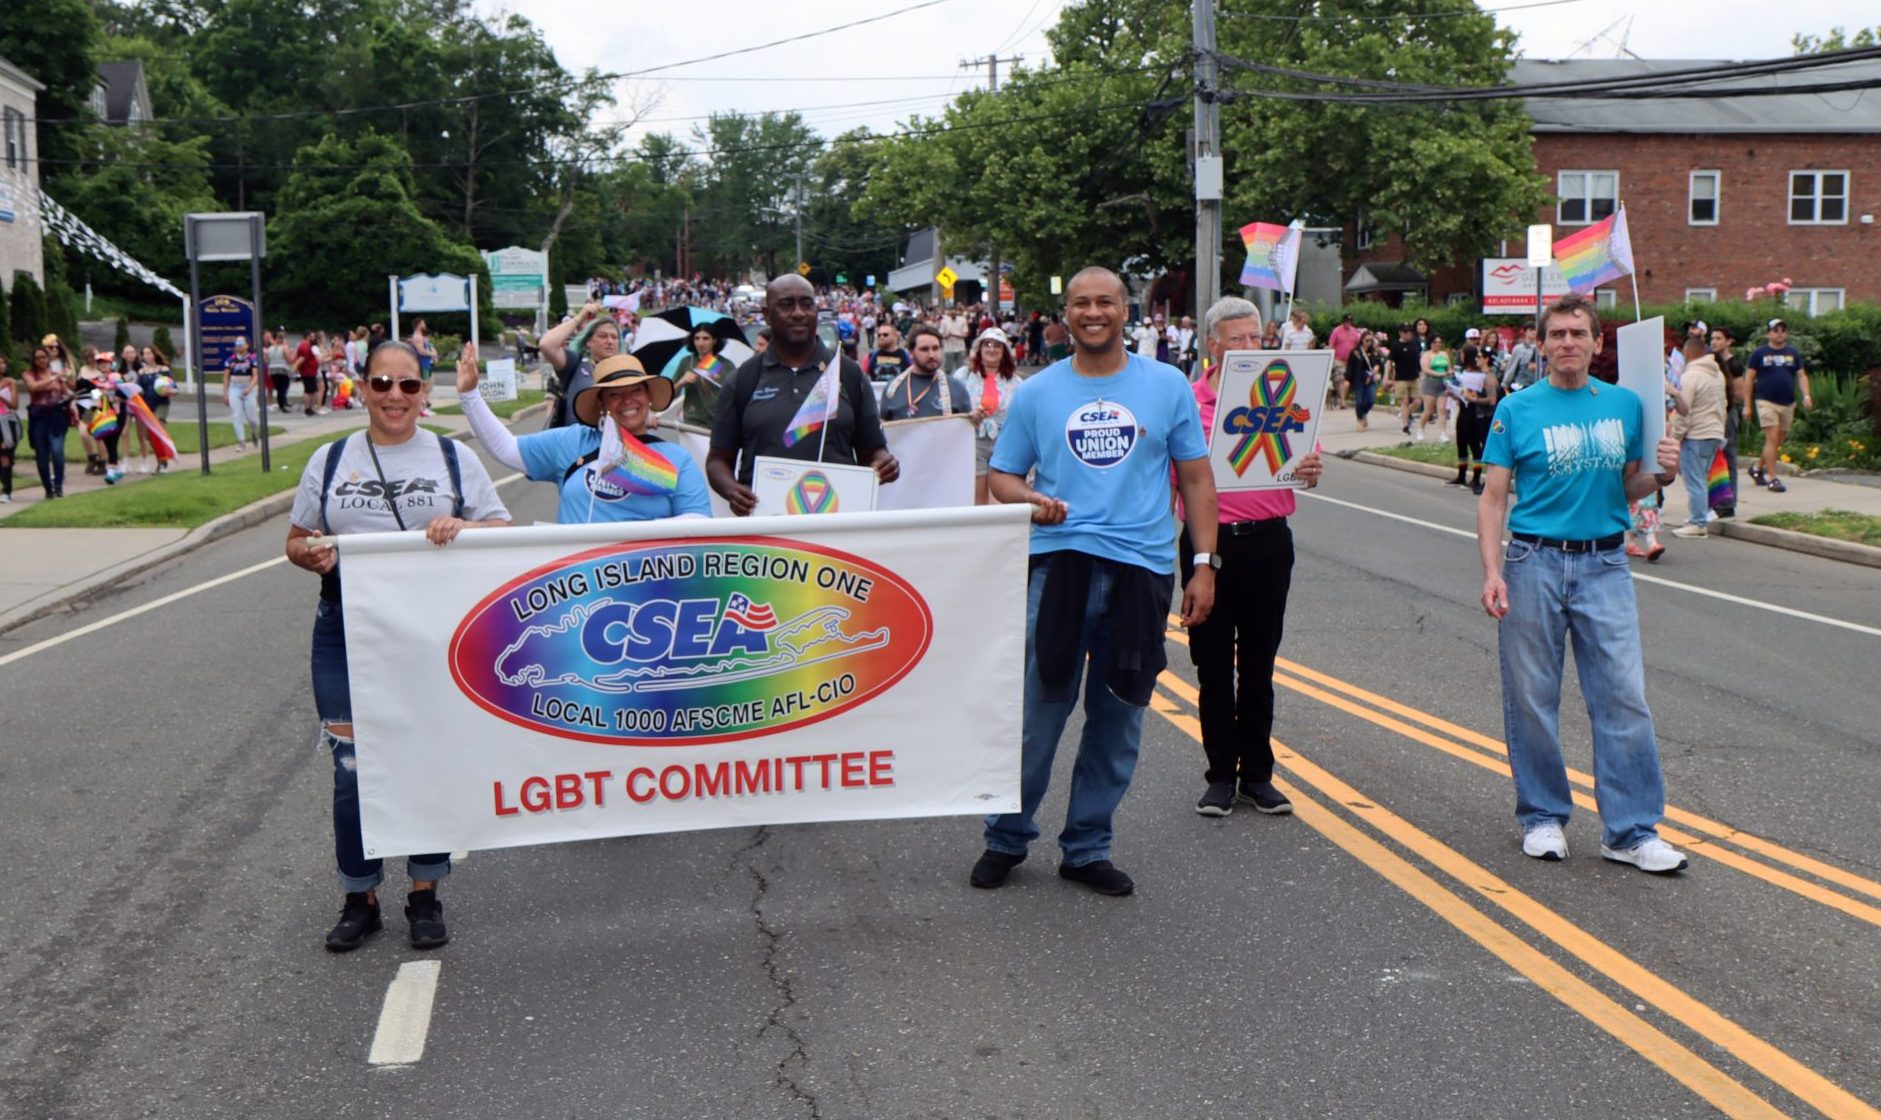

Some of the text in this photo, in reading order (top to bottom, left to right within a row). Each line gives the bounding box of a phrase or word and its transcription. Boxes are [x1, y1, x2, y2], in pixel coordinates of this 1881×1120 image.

[1080, 410, 1120, 422] CSEA
[1223, 404, 1308, 435] CSEA
[1076, 435, 1129, 452] UNION
[1084, 428, 1121, 438] PROUD
[1082, 449, 1124, 459] MEMBER
[335, 477, 440, 499] CSEA
[407, 496, 434, 508] 881
[512, 552, 874, 621] LONG ISLAND REGION ONE
[580, 593, 776, 665] CSEA
[532, 673, 856, 732] LOCAL 1000 AFSCME AFL-CIO
[493, 749, 895, 816] LGBT COMMITTEE
